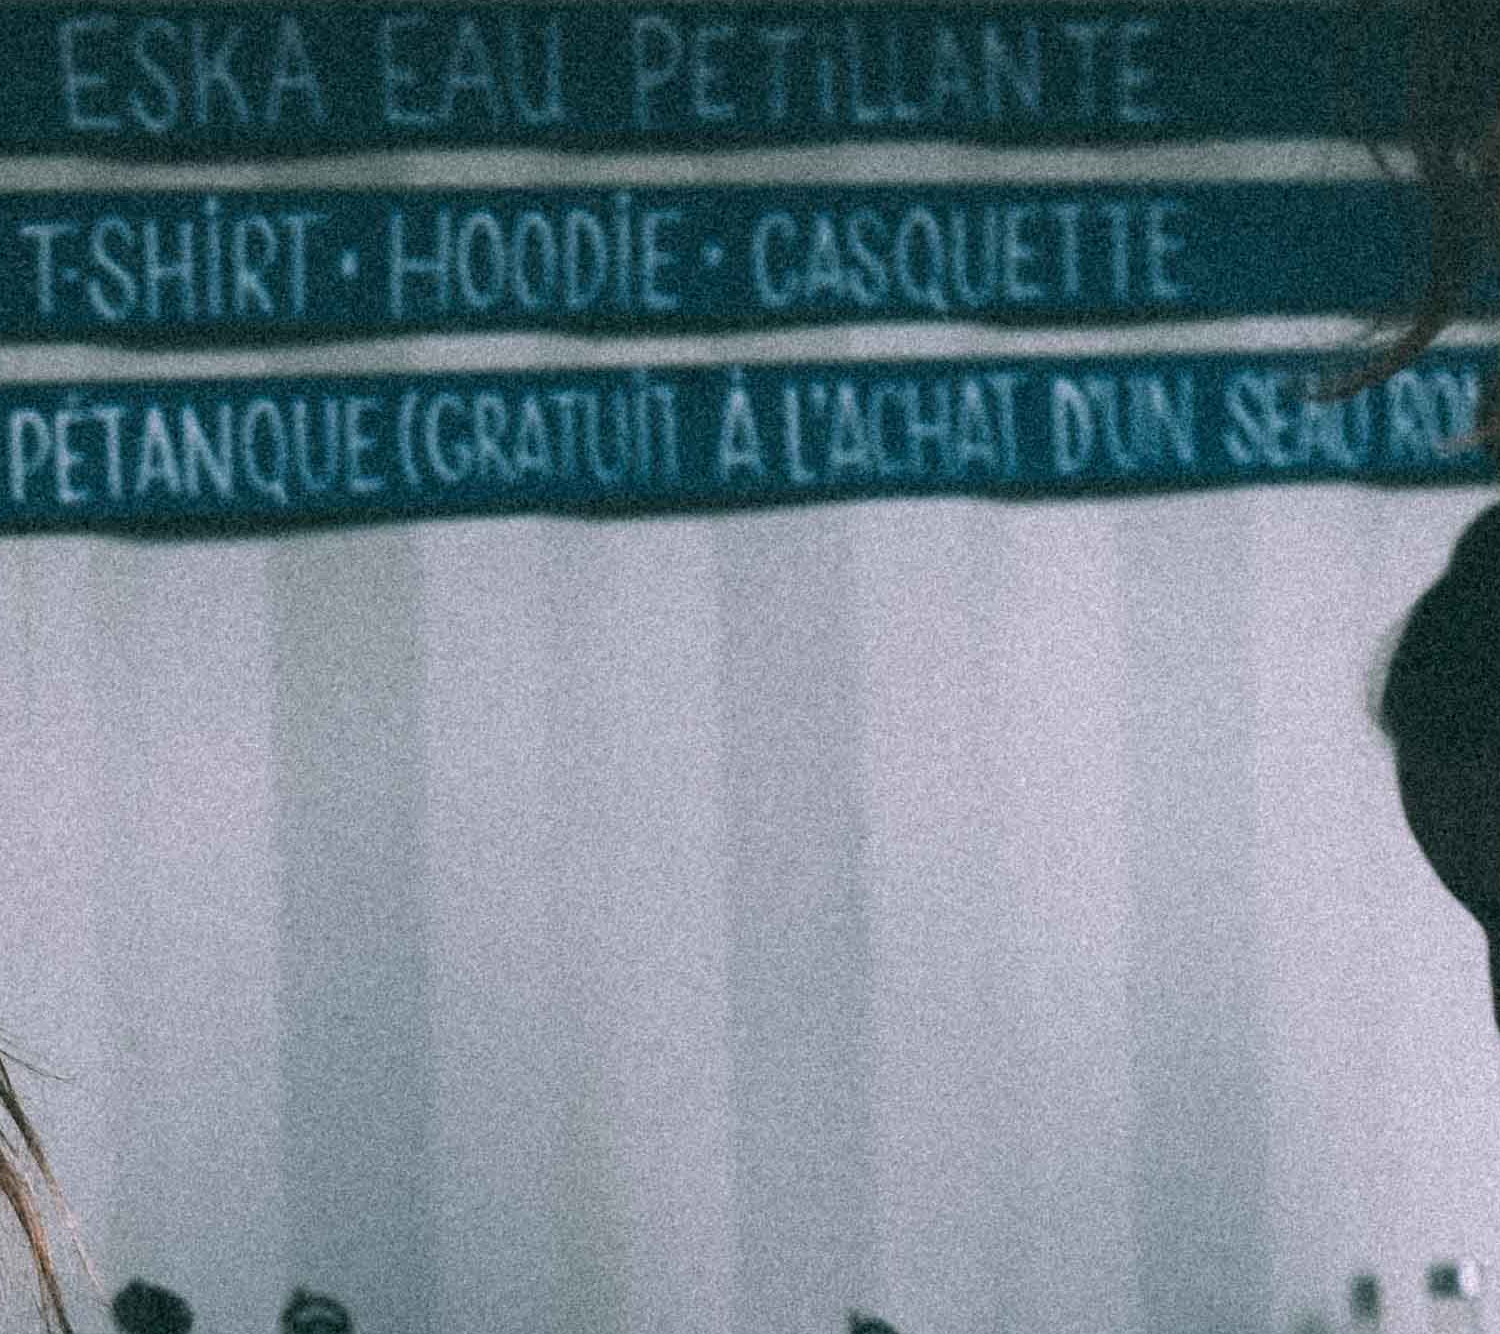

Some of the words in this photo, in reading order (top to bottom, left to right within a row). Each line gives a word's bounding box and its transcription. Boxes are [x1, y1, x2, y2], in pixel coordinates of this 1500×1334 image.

[56, 11, 326, 134] ESKA
[382, 11, 568, 127] EAU
[387, 186, 685, 315] HOODIE
[750, 197, 1193, 317] CASQUETTE
